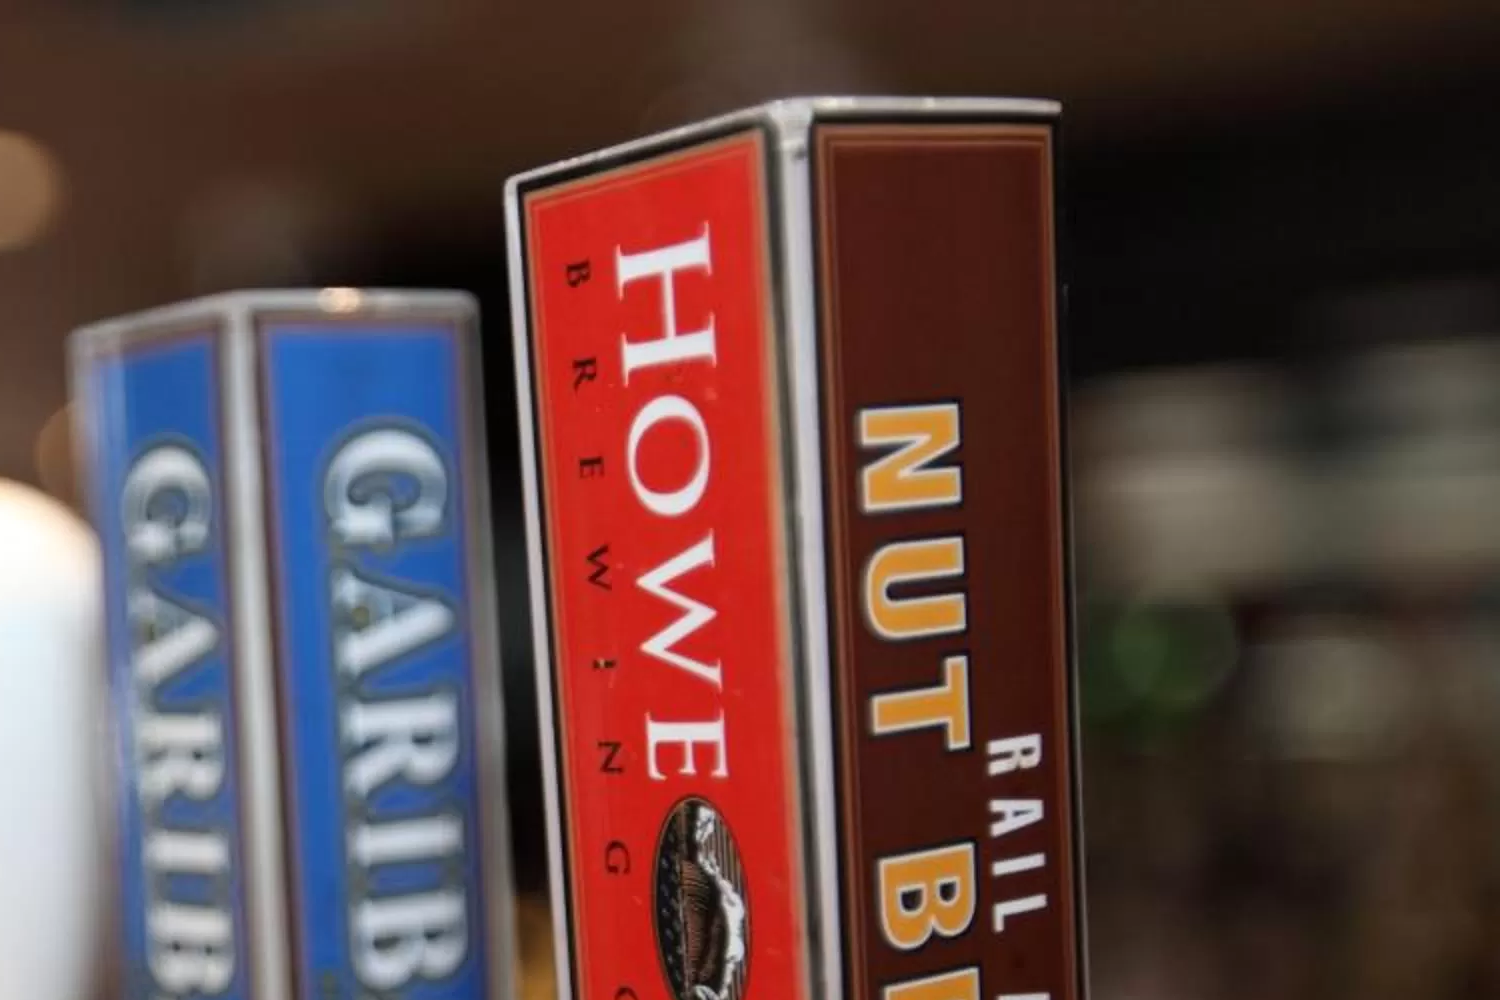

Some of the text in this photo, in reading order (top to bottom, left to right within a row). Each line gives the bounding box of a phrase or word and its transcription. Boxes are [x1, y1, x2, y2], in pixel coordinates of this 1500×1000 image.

[565, 259, 631, 876] BREWING
[615, 221, 728, 781] HOWE
[855, 401, 972, 750] NUT
[986, 733, 1048, 933] RAIL
